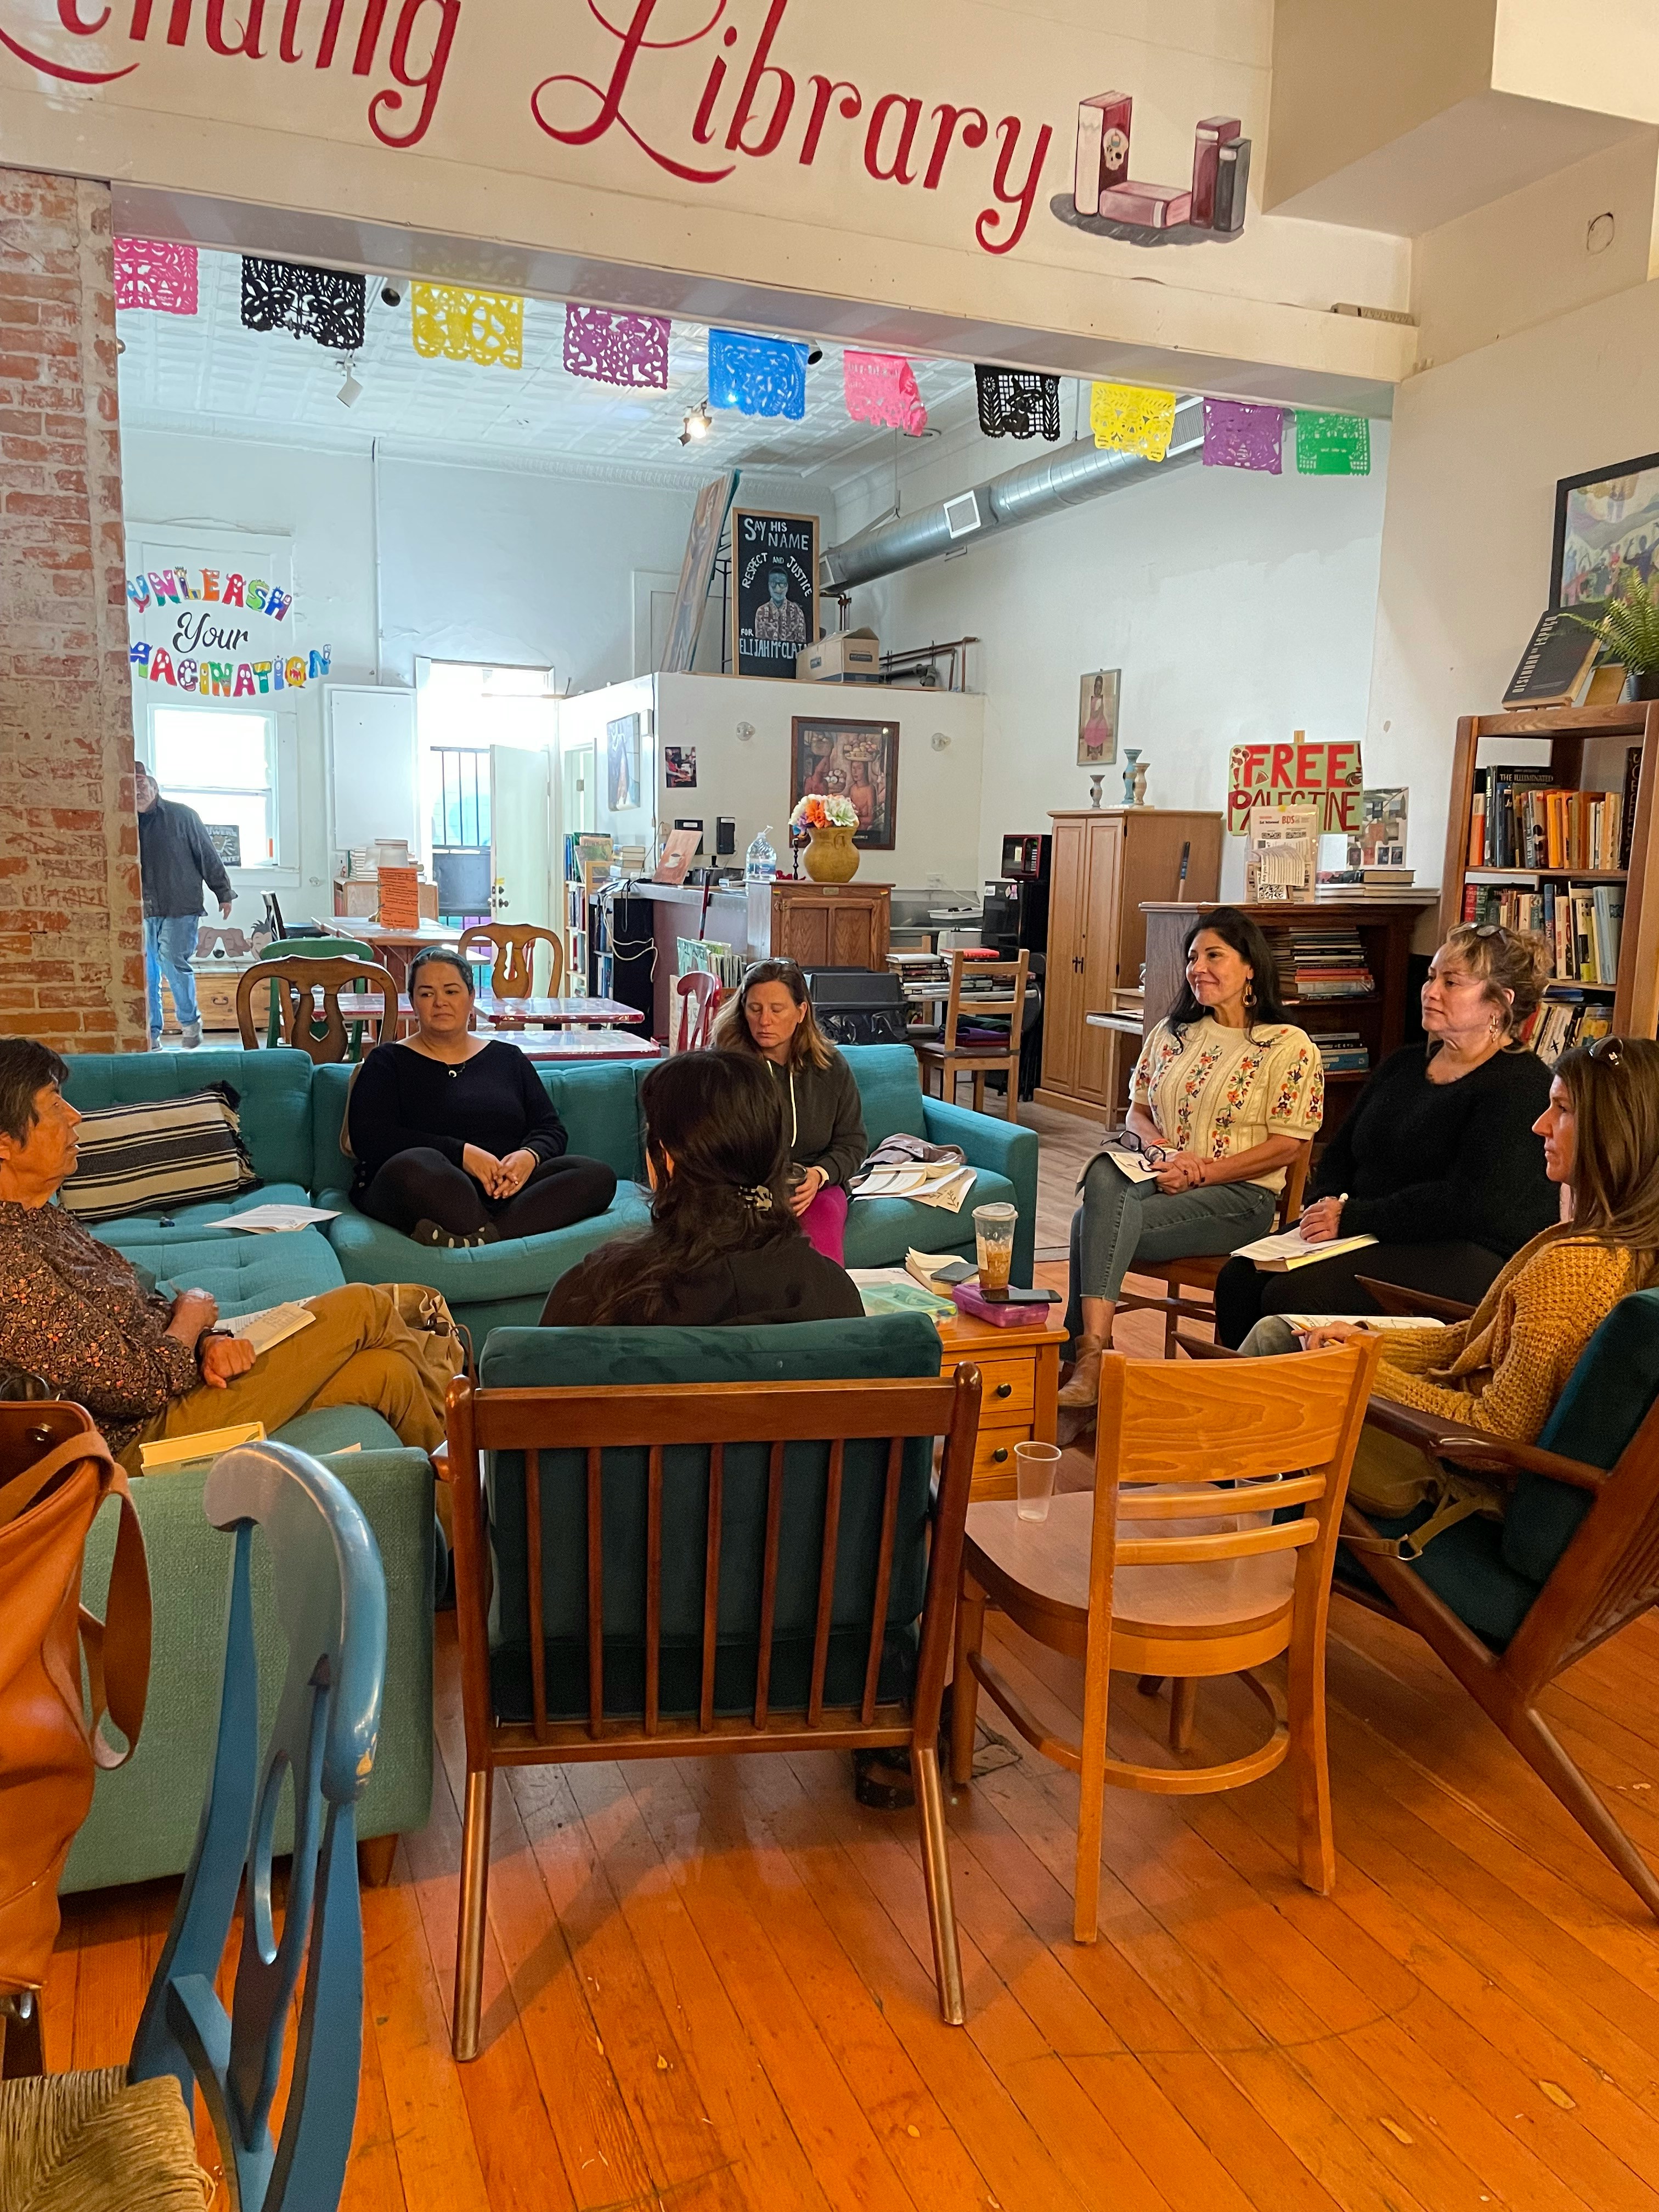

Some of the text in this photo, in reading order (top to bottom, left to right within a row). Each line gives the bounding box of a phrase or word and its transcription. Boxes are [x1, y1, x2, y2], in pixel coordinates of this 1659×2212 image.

[530, 0, 1053, 255] Library
[744, 518, 787, 541] SAY HIS
[768, 533, 809, 550] NAME
[742, 552, 768, 589] RESPECT
[786, 555, 813, 597] JUSTICE
[127, 567, 292, 621] UNLEASH
[173, 612, 249, 653] Your
[739, 638, 770, 658] ELIJAH
[741, 628, 754, 636] FOR
[130, 643, 331, 697] MAGINATION
[1243, 744, 1355, 788] FREE
[1499, 774, 1513, 782] THE
[1282, 815, 1295, 824] BDS
